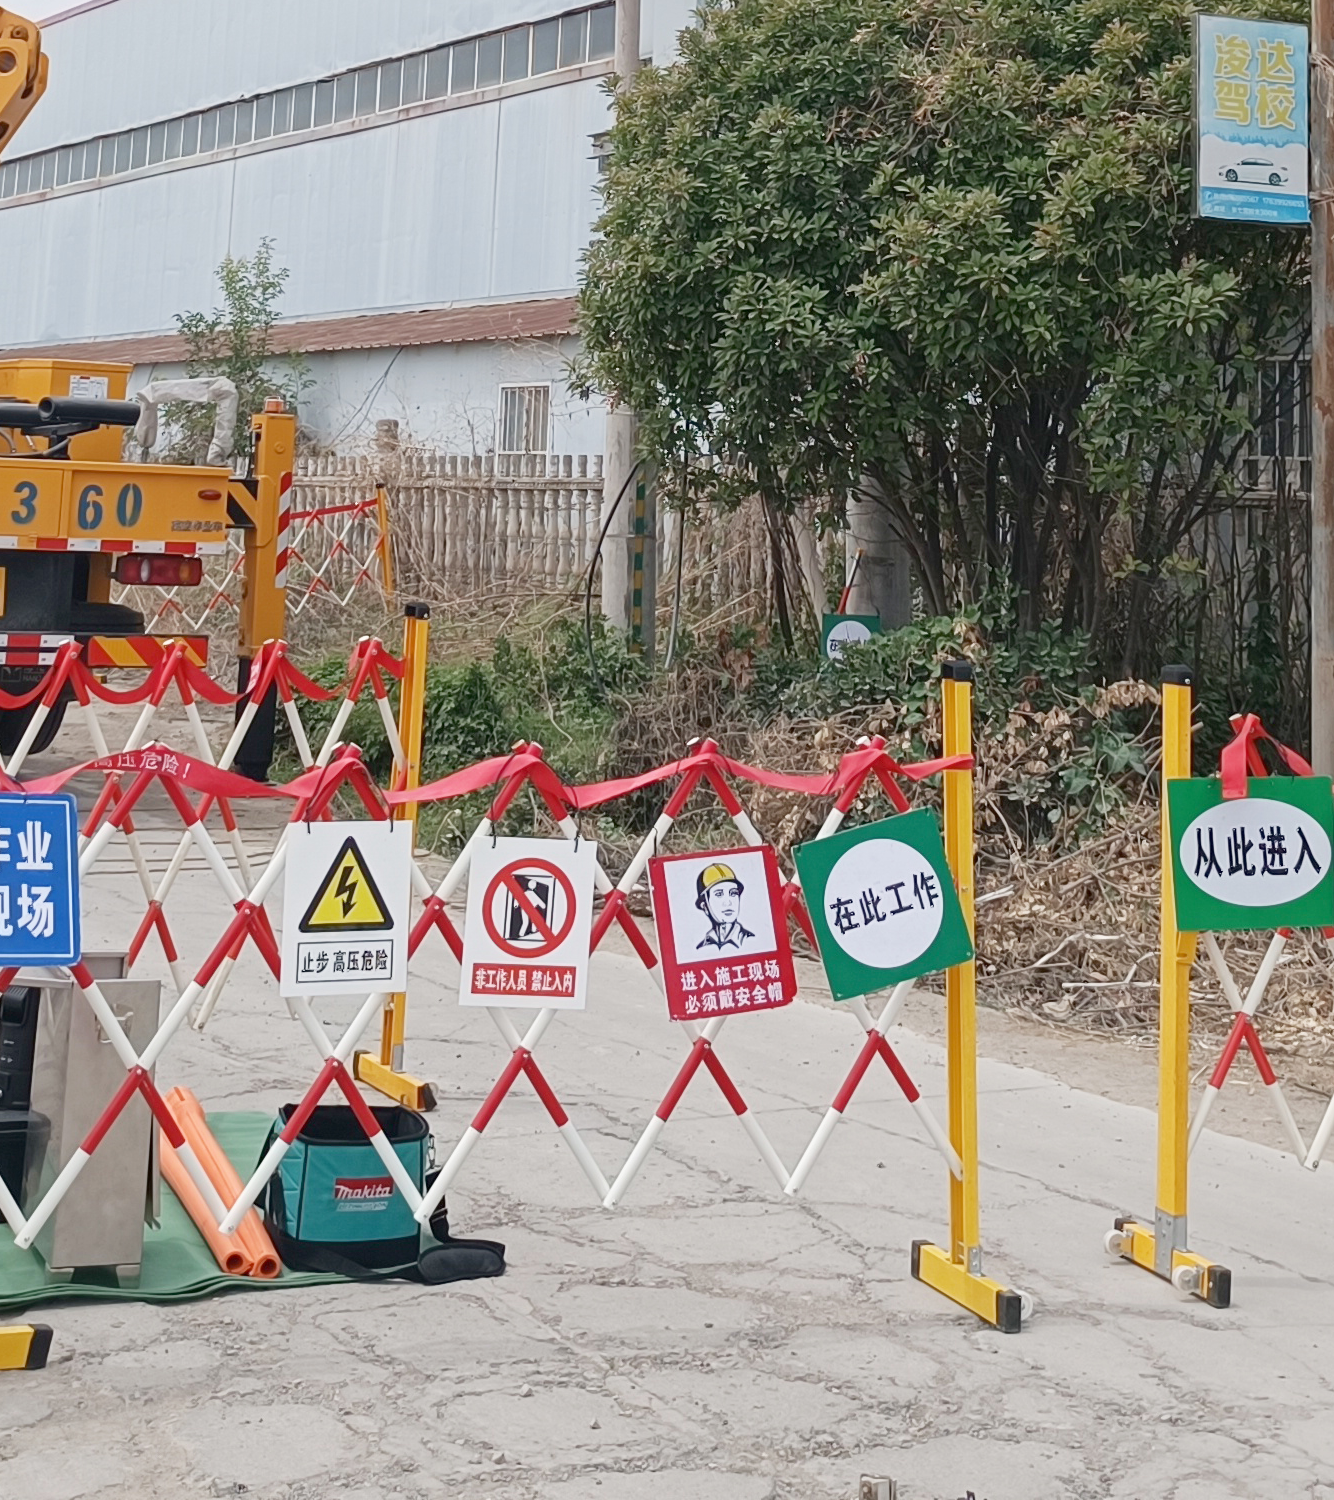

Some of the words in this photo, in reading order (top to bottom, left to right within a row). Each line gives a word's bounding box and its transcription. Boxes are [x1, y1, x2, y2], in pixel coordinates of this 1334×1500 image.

[1213, 80, 1296, 131] 驾校
[1194, 826, 1322, 879] 从此进入
[829, 871, 939, 935] 在此工作
[301, 951, 330, 974] 止步
[332, 948, 389, 974] 高压危险
[680, 959, 781, 992] 进入施工现场
[474, 967, 527, 992] 非工作人员
[531, 970, 573, 993] 禁止入内
[684, 981, 784, 1015] 必须戴安全帽
